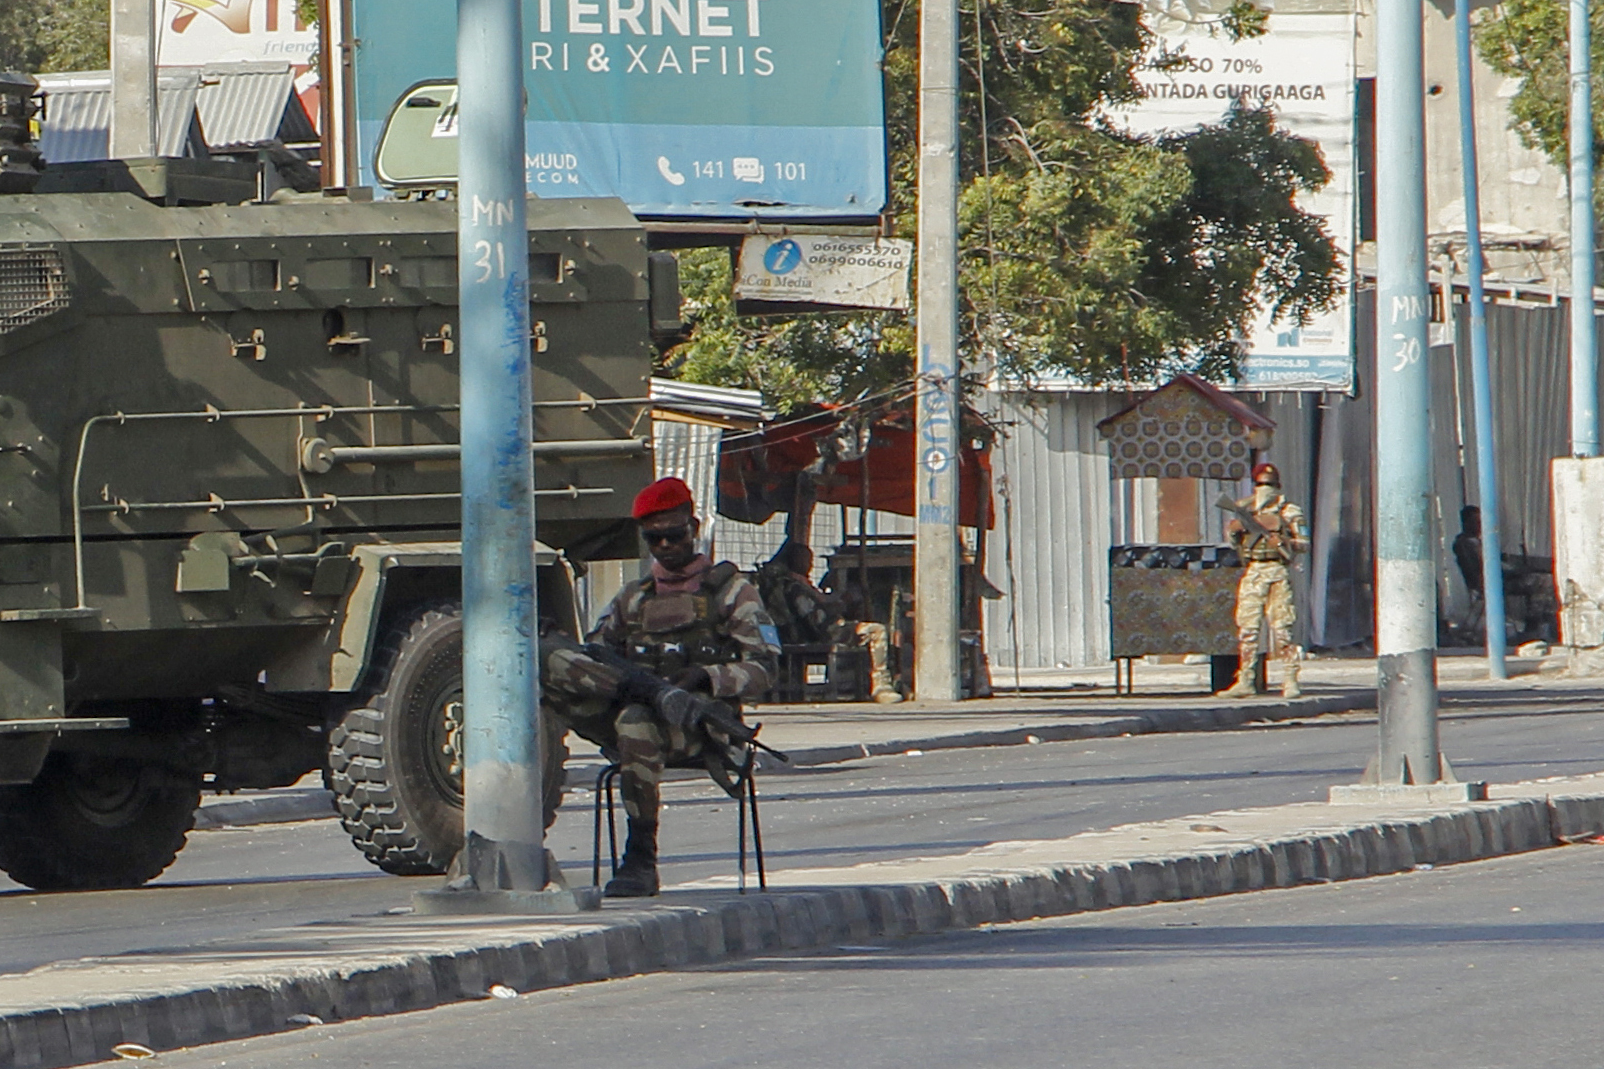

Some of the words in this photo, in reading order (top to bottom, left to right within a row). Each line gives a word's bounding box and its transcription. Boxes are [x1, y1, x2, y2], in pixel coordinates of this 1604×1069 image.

[531, 41, 569, 71] RI
[586, 42, 611, 72] &
[625, 44, 775, 77] XAFIIS
[1222, 58, 1263, 74] 70%
[1212, 83, 1326, 101] GURIGAAGA
[525, 153, 578, 170] MUUD
[692, 160, 724, 179] 141
[774, 161, 807, 180] 101
[471, 195, 514, 227] MN
[474, 240, 505, 283] 31
[774, 276, 813, 288] Media
[1391, 295, 1425, 325] MN
[1391, 332, 1421, 372] 30
